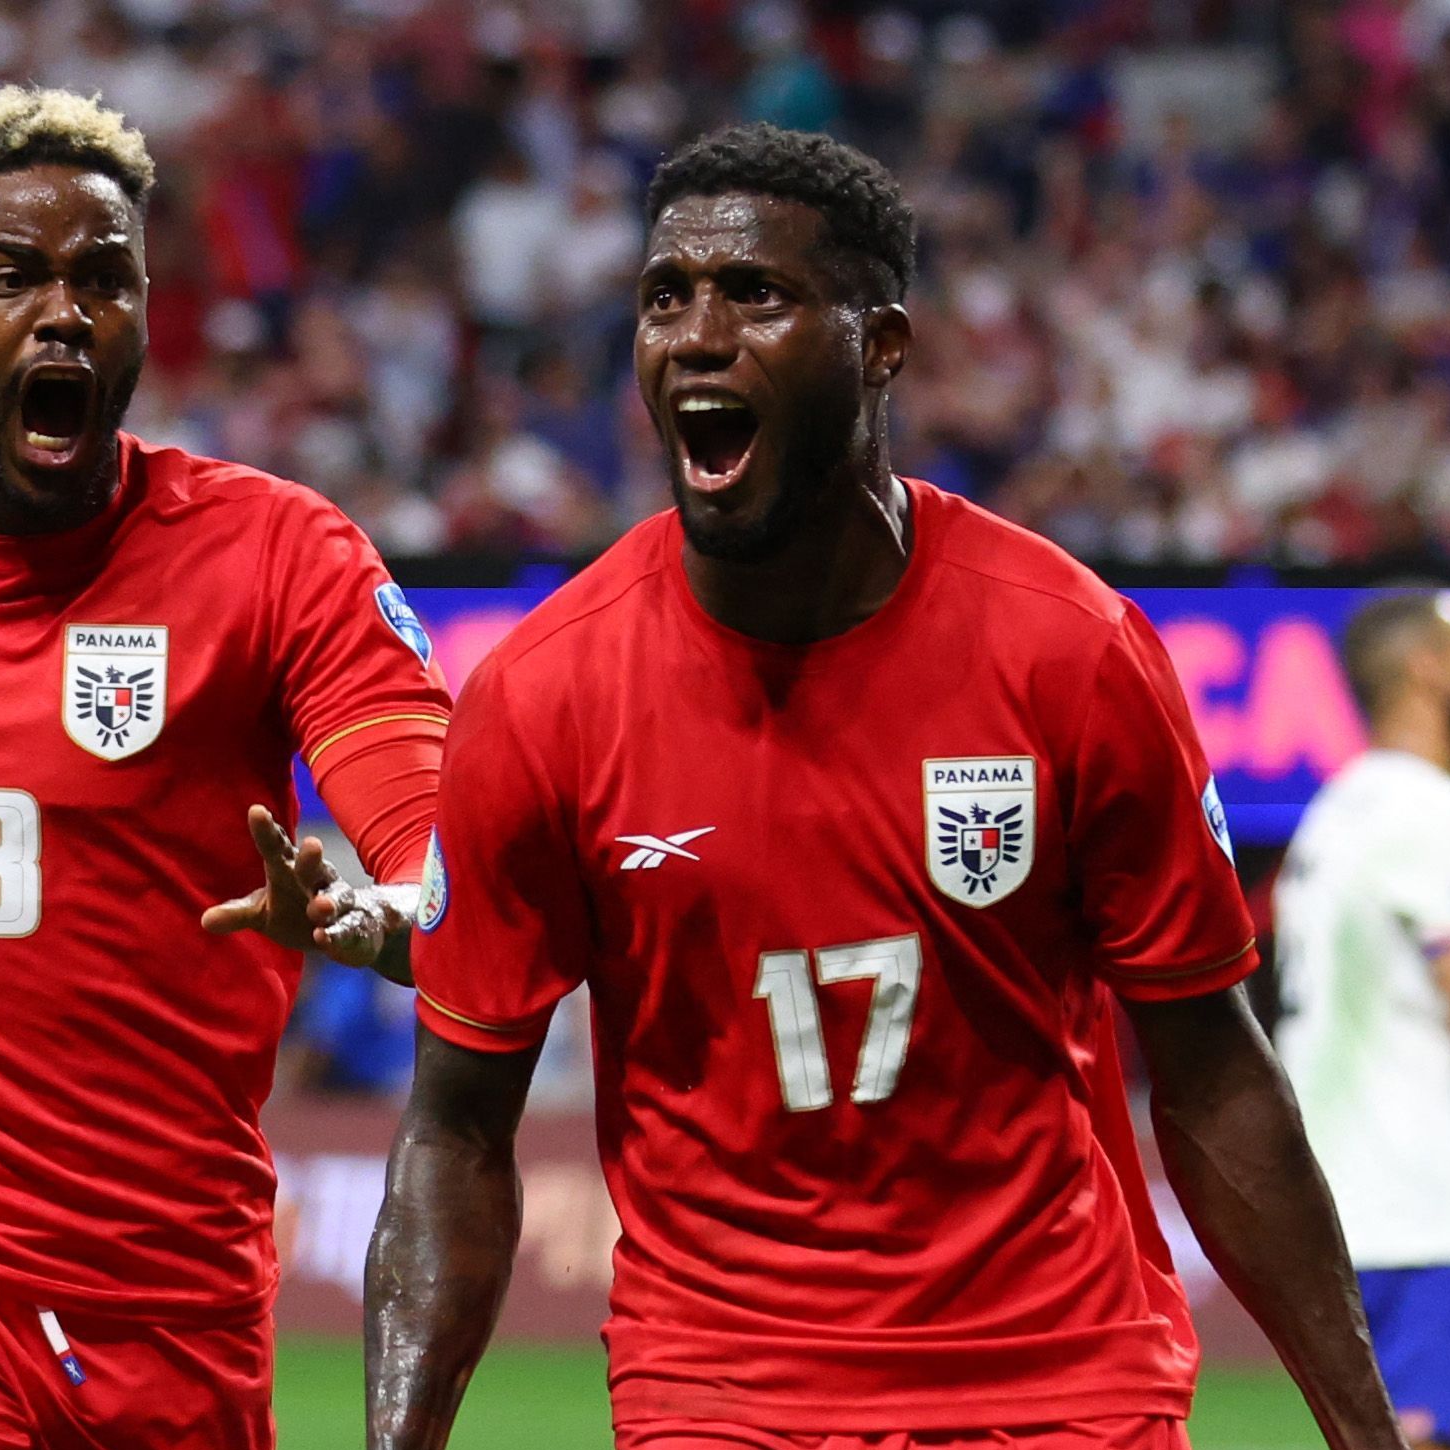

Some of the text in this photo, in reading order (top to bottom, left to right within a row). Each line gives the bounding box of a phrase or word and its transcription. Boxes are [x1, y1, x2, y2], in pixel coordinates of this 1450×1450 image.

[76, 631, 157, 649] PANAMÁ
[934, 763, 1024, 785] PANAMÁ
[752, 931, 921, 1113] 17
